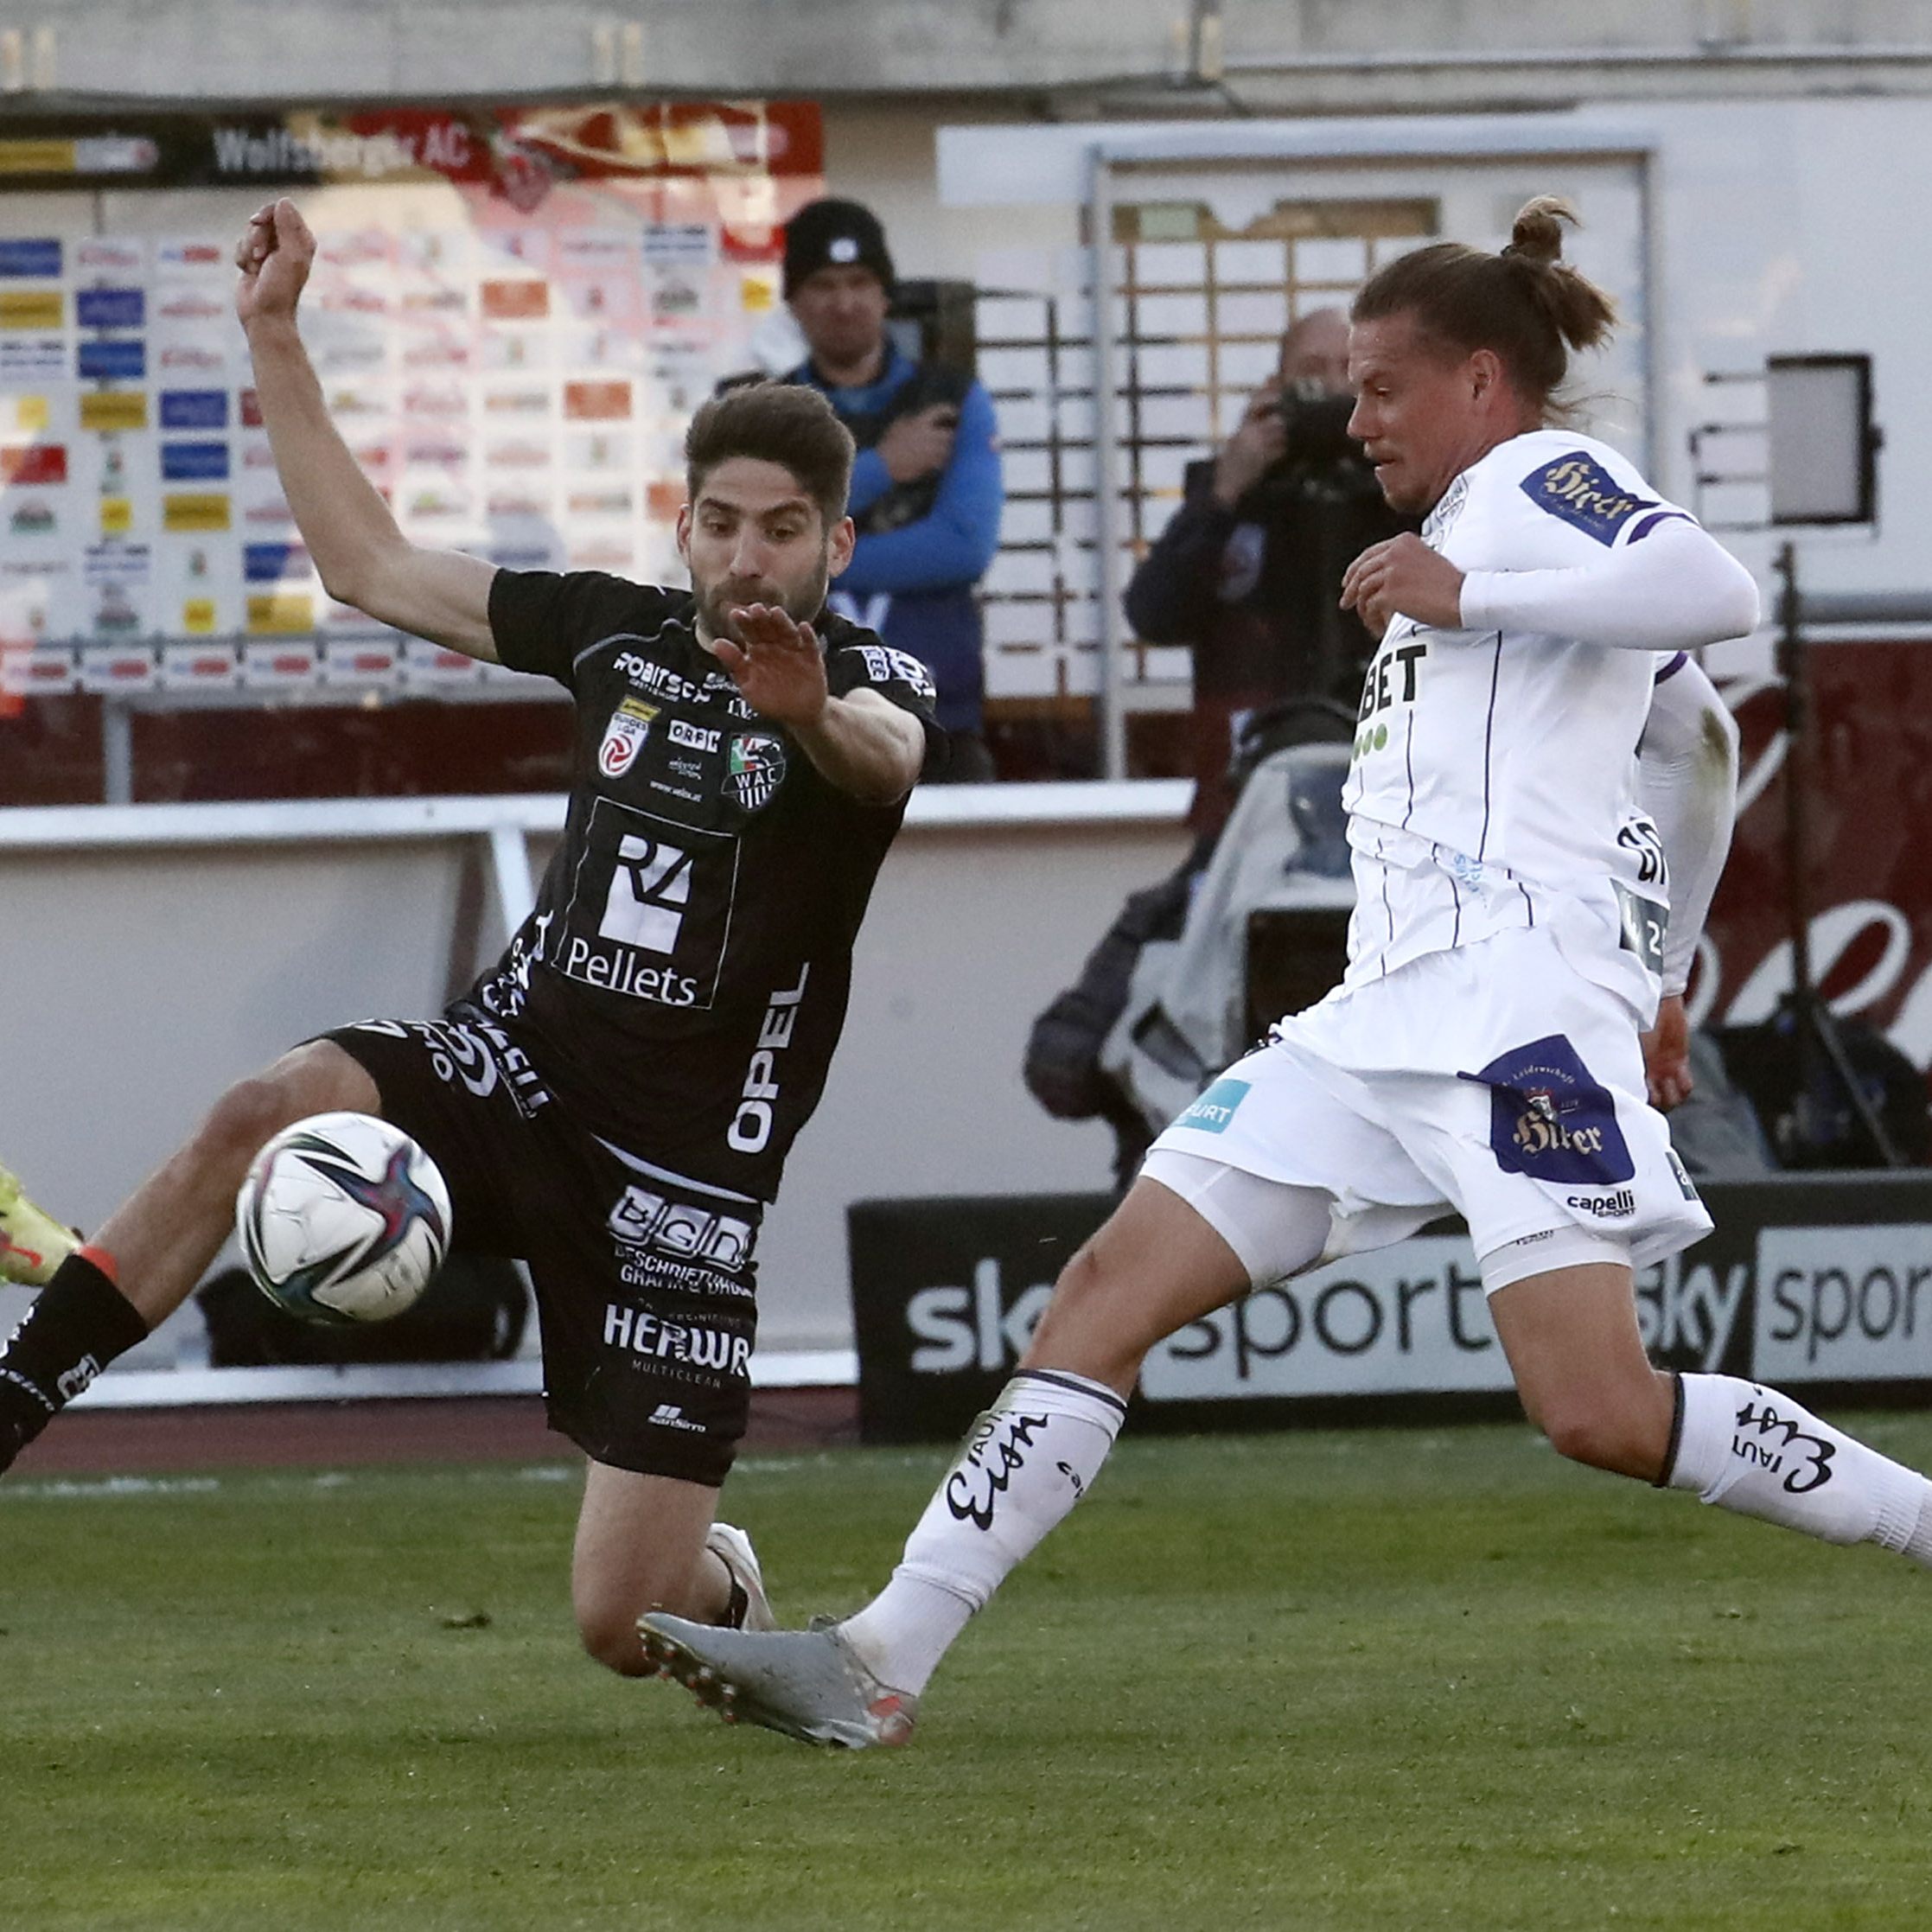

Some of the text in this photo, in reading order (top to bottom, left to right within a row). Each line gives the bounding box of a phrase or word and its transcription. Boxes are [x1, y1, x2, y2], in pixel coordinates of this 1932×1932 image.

[736, 767, 777, 789] WAC
[566, 937, 698, 1007] Pellets
[726, 961, 811, 1154] OPEL
[1566, 1189, 1635, 1215] capelli
[907, 1257, 1055, 1373] sk
